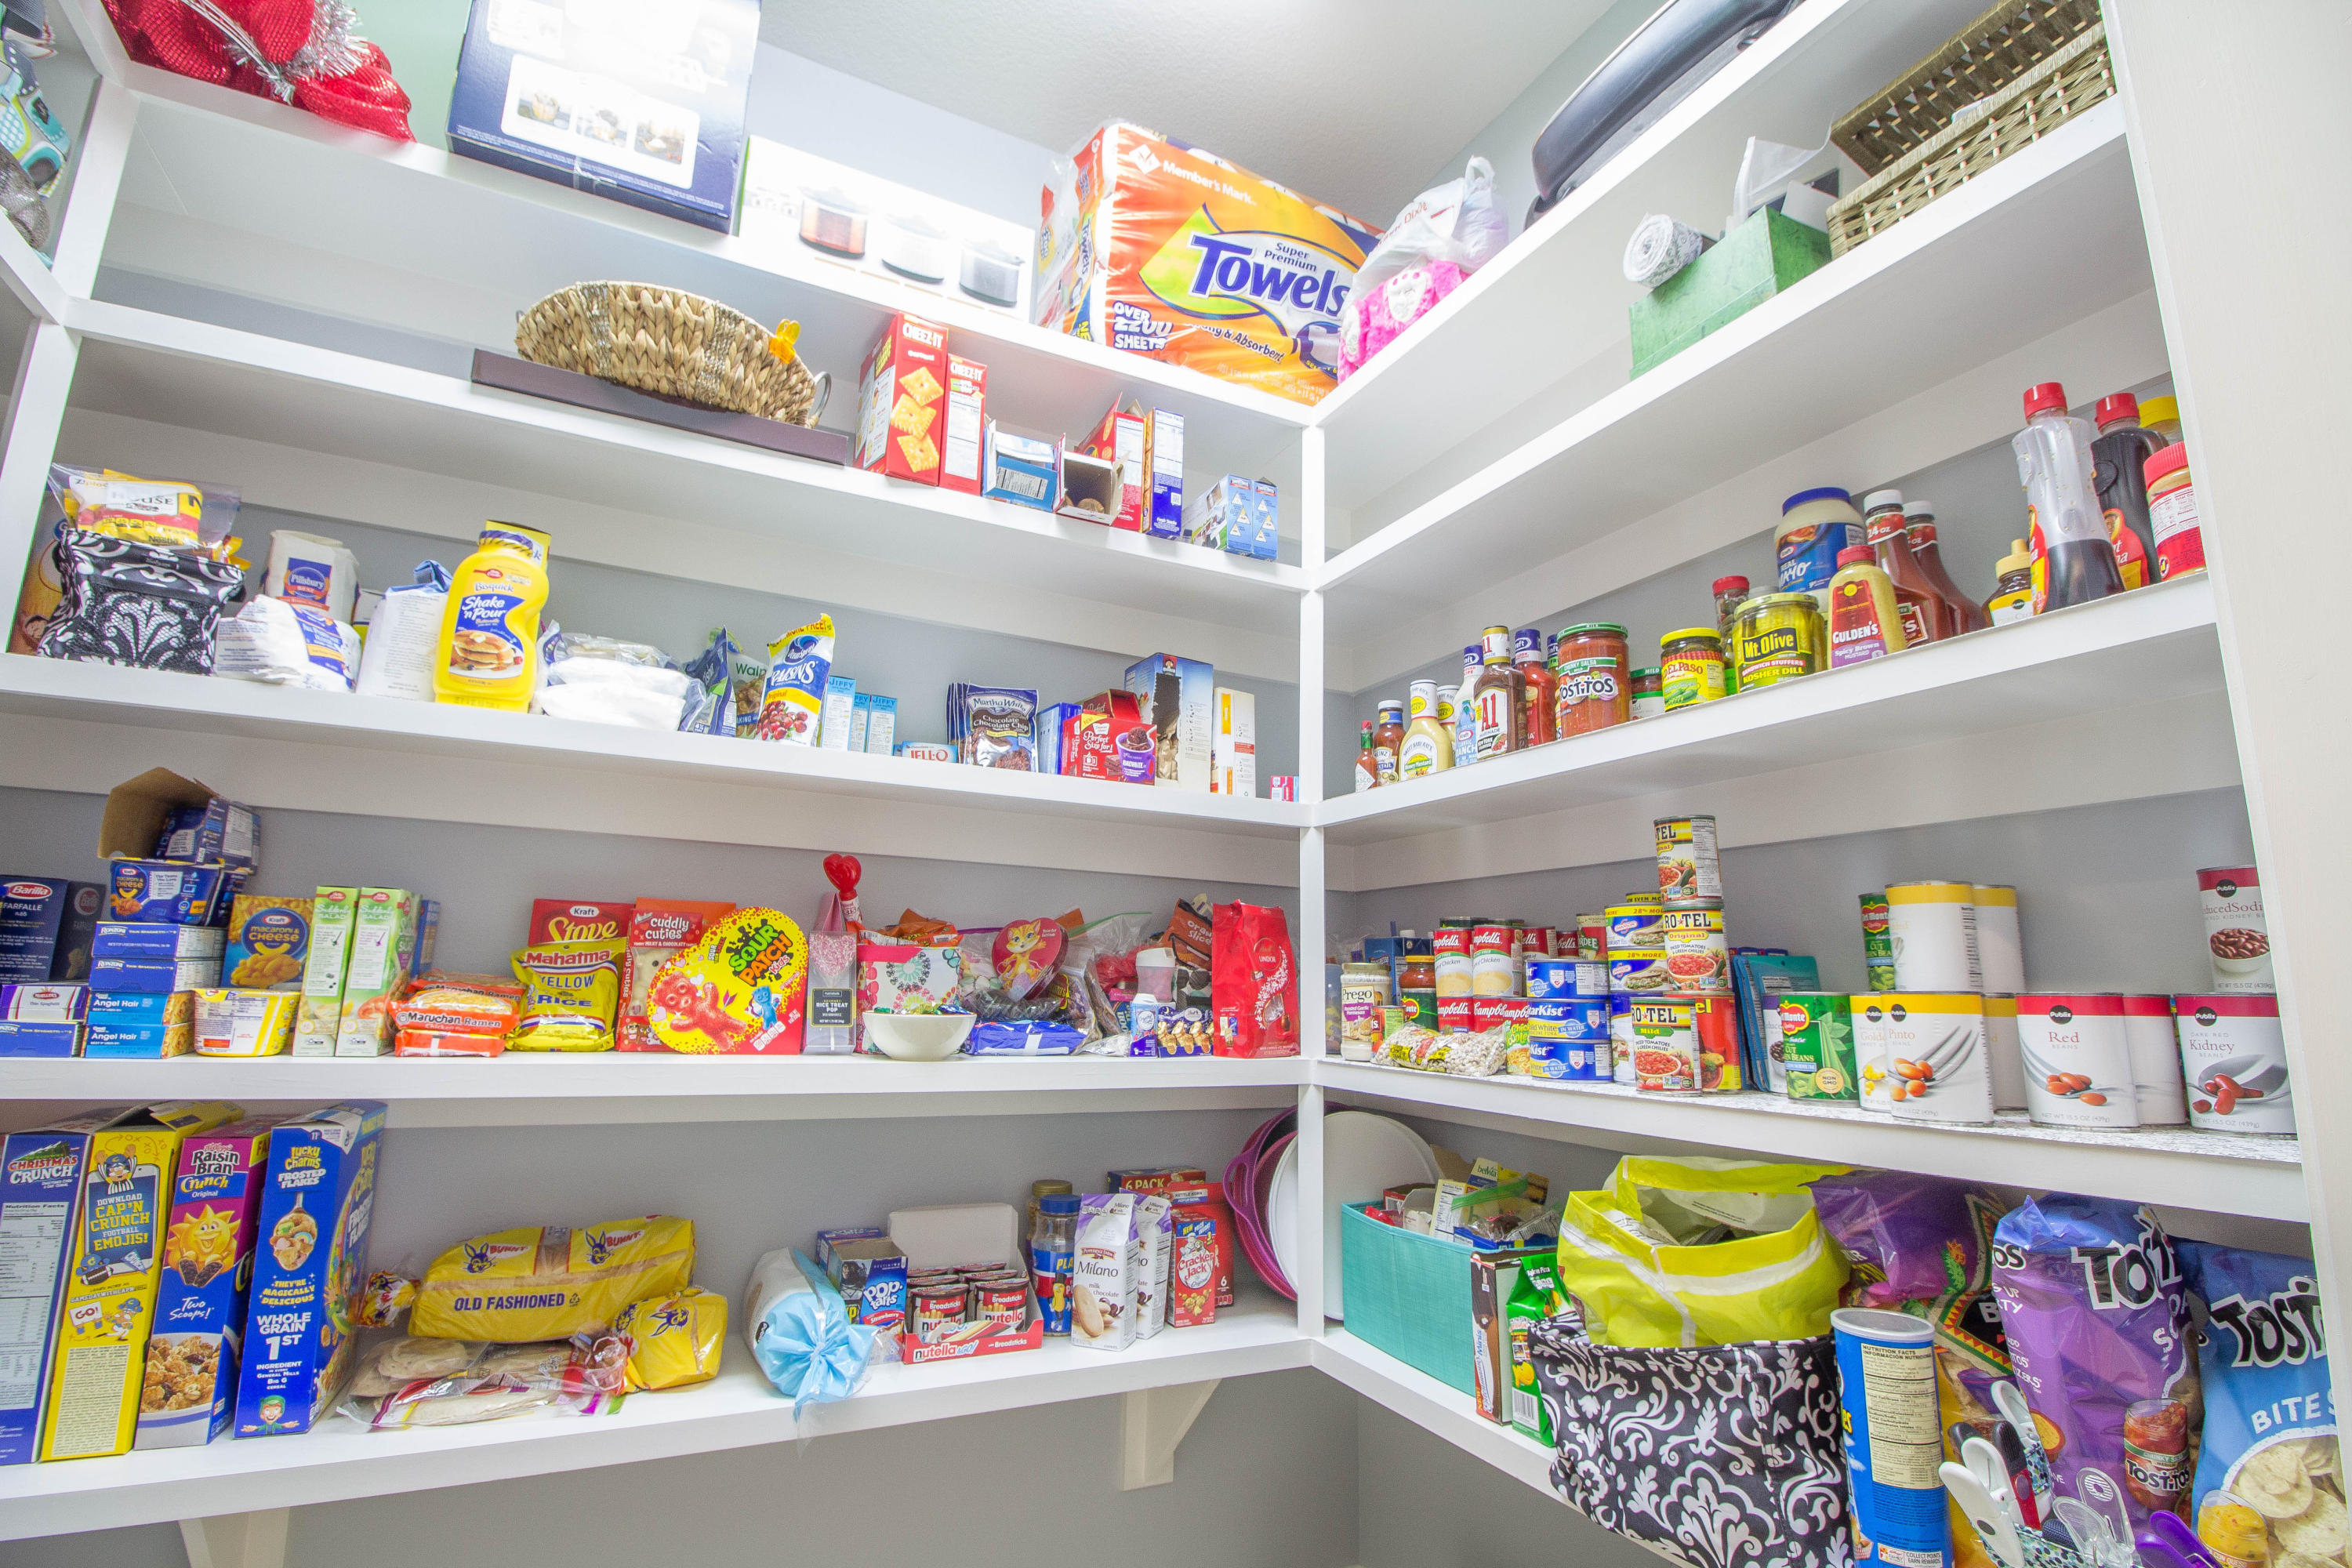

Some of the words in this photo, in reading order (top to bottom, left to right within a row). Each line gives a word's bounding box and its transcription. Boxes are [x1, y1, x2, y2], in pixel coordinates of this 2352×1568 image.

[1162, 160, 1221, 191] Member's
[1275, 241, 1310, 260] Super
[1263, 249, 1318, 274] Premium
[1113, 302, 1151, 321] OVER
[1233, 332, 1286, 364] Absorbent
[1867, 525, 1877, 539] 24
[462, 596, 506, 611] Shake
[472, 608, 507, 621] Pour
[1833, 622, 1878, 644] GULDEN'S
[1744, 641, 1761, 659] Mt.
[1761, 633, 1794, 654] Olive
[1743, 669, 1780, 684] KOSHER
[973, 698, 1003, 708] Martha
[974, 720, 1010, 729] Chocolate
[1011, 722, 1029, 731] Chip
[12, 886, 48, 895] Barilla
[574, 908, 596, 916] Kraft
[549, 916, 619, 942] Stove
[650, 916, 689, 932] cuddly
[645, 928, 683, 940] cuties
[729, 925, 779, 972] SOUR
[526, 949, 611, 965] Mahatma
[739, 933, 793, 986] PATCH
[540, 974, 596, 989] YELLOW
[93, 1000, 120, 1008] Angel
[536, 995, 593, 1007] RICE
[408, 1012, 461, 1024] Maruchan
[464, 1018, 501, 1027] Ramen
[2195, 1013, 2218, 1022] Publix
[91, 1033, 118, 1041] Angel
[1888, 1028, 1915, 1040] Pinto
[2049, 1031, 2080, 1044] Red
[2189, 1040, 2235, 1055] Kidney
[8, 1156, 78, 1171] CHRISTMAS
[191, 1149, 240, 1165] Raisin
[9, 1165, 74, 1185] CRUNCH
[195, 1163, 234, 1175] Bran
[278, 1168, 327, 1181] FROSTED
[180, 1176, 229, 1192] Crunch
[281, 1178, 321, 1189] FLAKES
[1135, 1178, 1166, 1189] PACK
[96, 1193, 143, 1207] DOWNLOAD
[95, 1200, 144, 1218] CAP'N
[90, 1212, 151, 1232] CRUNCH
[103, 1227, 140, 1238] FOOTBALL
[605, 1230, 642, 1247] BUNNY
[93, 1232, 149, 1251] EMOJIS!
[1178, 1252, 1214, 1271] Cracker
[1076, 1261, 1119, 1278] Milano
[1184, 1263, 1207, 1281] Jack
[274, 1279, 307, 1287] THEY'RE
[1221, 1276, 1227, 1286] 6
[262, 1285, 315, 1298] MAGICALLY
[992, 1294, 1022, 1304] Breadsticks
[1093, 1289, 1120, 1298] chocolate
[182, 1296, 206, 1312] Two
[261, 1294, 315, 1305] DELICIOUS
[454, 1297, 482, 1312] OLD
[486, 1293, 565, 1310] FASHIONED
[929, 1300, 961, 1310] Breadsticks
[75, 1306, 99, 1319] GO!
[256, 1312, 312, 1326] WHOLE
[985, 1310, 1022, 1323] nutella
[260, 1323, 307, 1334] GRAIN
[915, 1343, 956, 1359] nutella
[994, 1339, 1027, 1348] Breadsticks
[1863, 1345, 1896, 1356] NUTRITION
[256, 1361, 303, 1370] INGREDIENT
[2251, 1394, 2321, 1436] BITE
[2127, 1461, 2190, 1491] TOSTITOS
